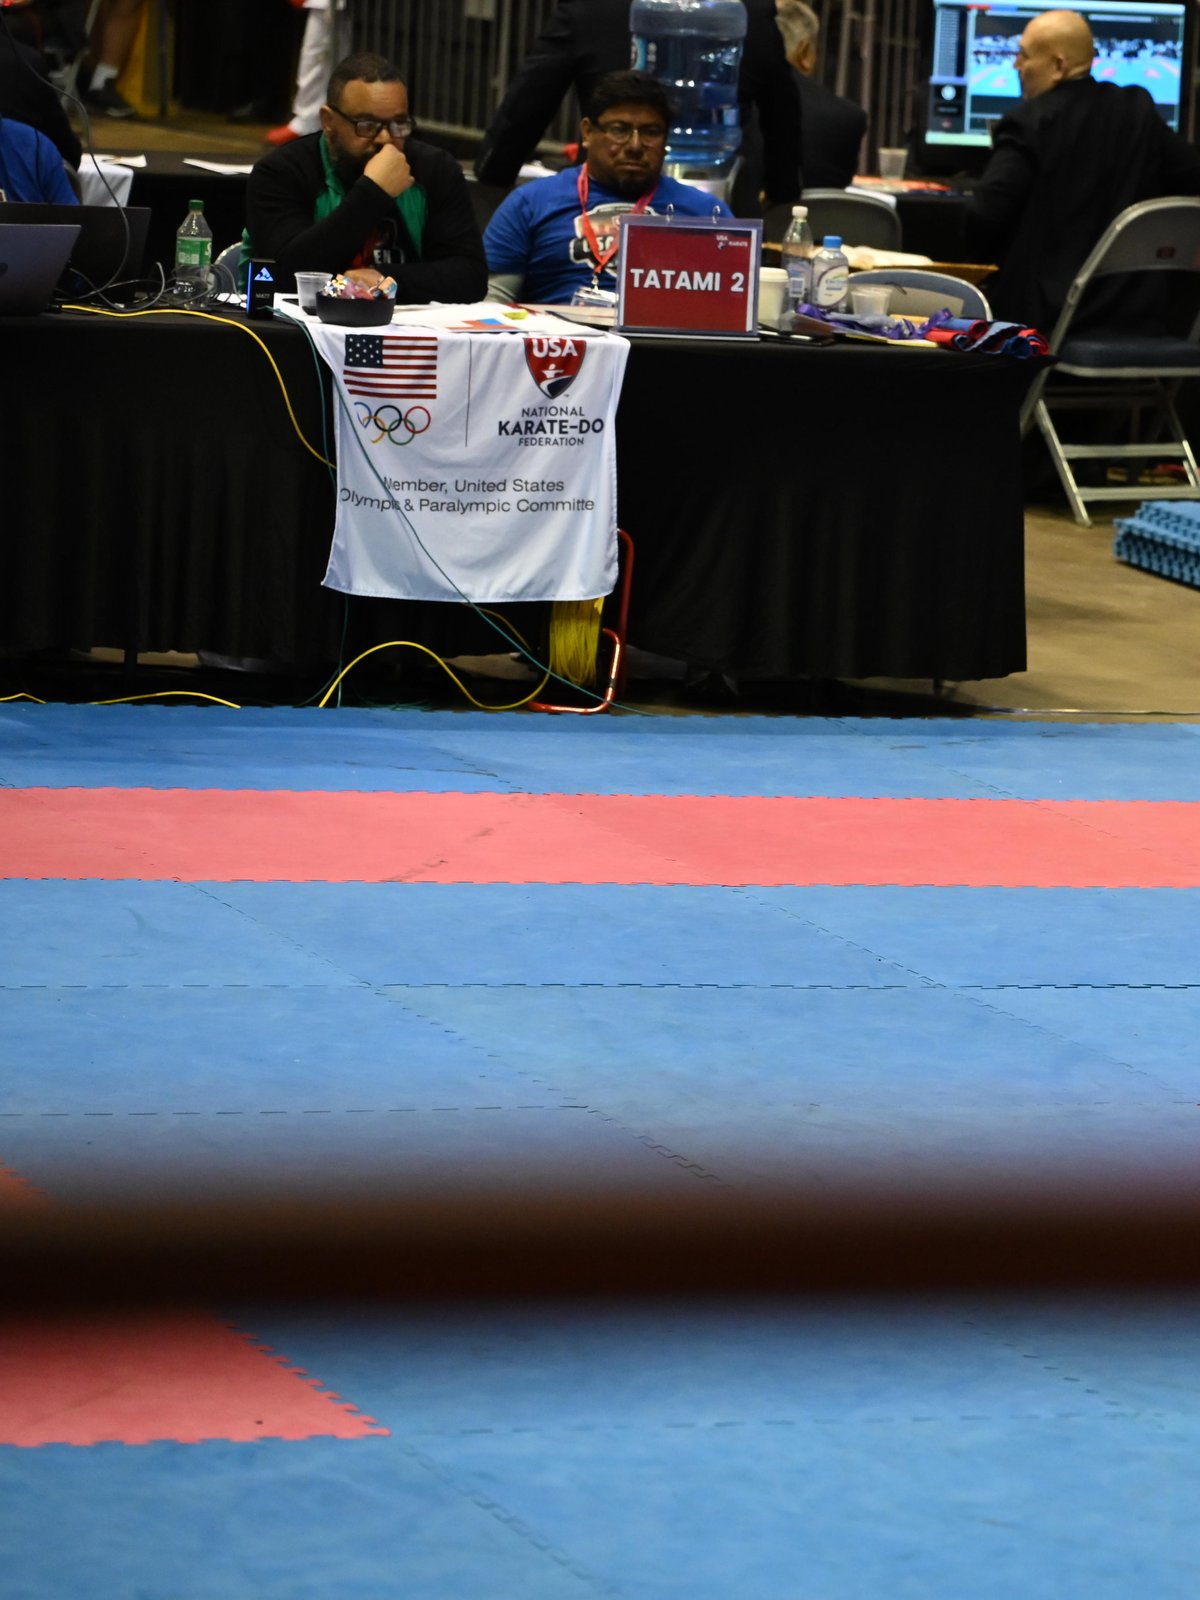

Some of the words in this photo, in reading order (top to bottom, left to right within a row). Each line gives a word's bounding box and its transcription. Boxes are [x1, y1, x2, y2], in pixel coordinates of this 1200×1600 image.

[630, 268, 720, 291] TATAMI
[730, 272, 744, 292] 2
[532, 338, 578, 358] USA
[521, 406, 585, 418] NATIONAL
[498, 418, 604, 436] KARATE-DO
[518, 436, 585, 447] FEDERATION
[454, 478, 507, 492] United
[512, 478, 564, 491] States
[404, 499, 414, 511] &
[419, 498, 510, 515] Paralympic
